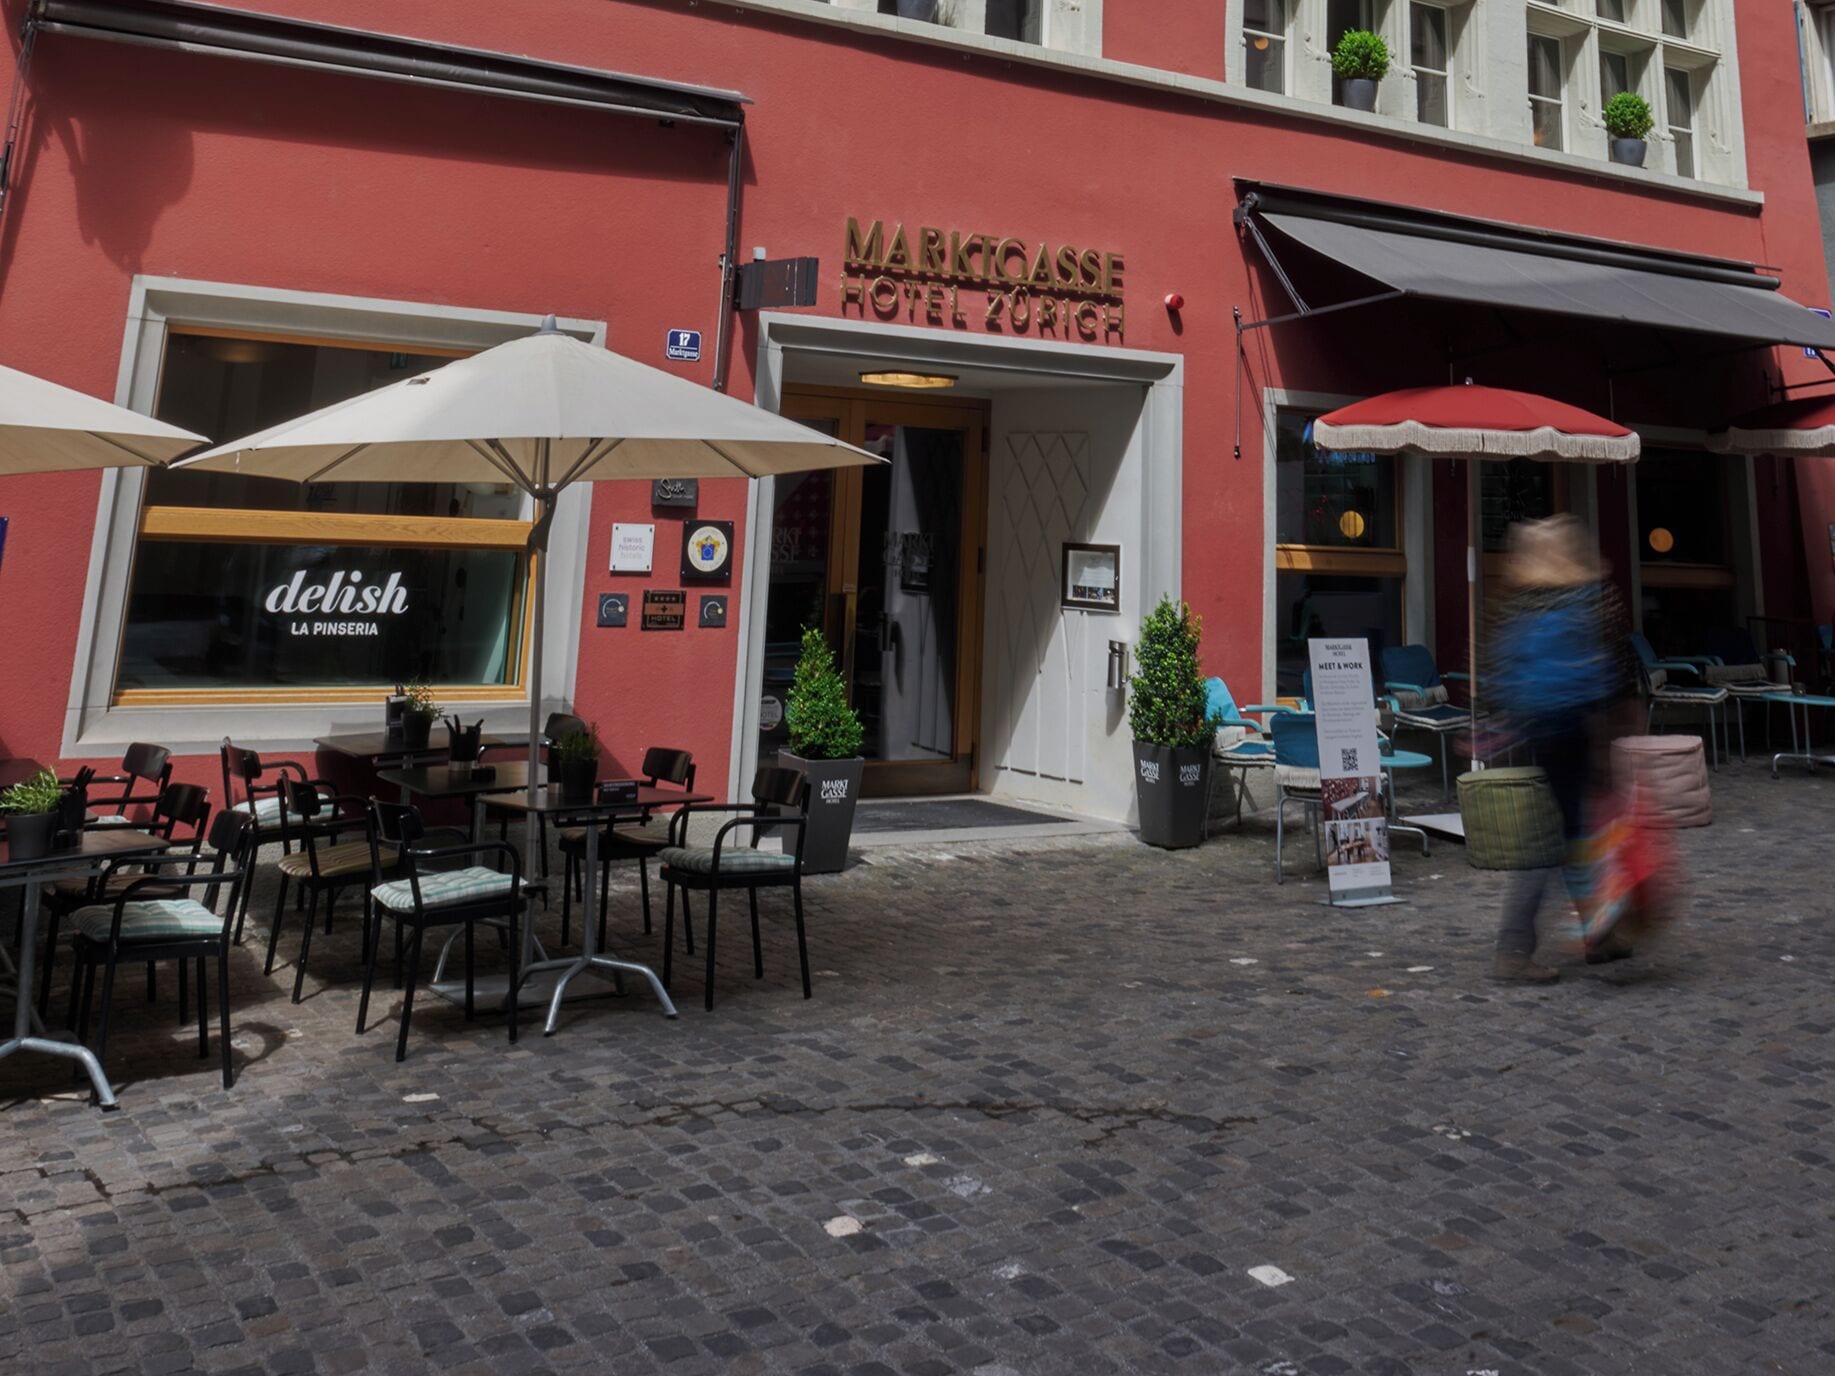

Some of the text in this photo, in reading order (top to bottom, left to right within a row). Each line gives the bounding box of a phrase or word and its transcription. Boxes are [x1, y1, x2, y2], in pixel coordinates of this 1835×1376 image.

[844, 217, 1124, 297] MARKTGASSE
[840, 272, 1125, 333] HOTEL ZÜRICH
[679, 332, 690, 346] 17
[622, 536, 643, 544] swiss
[618, 543, 645, 552] historic
[265, 570, 409, 614] delish
[651, 614, 676, 622] HOTEL
[291, 622, 379, 635] LA PINSERIA
[1319, 662, 1335, 670] MEET
[1343, 662, 1363, 670] WORK
[821, 779, 848, 790] MARKT
[821, 789, 847, 799] GASSE
